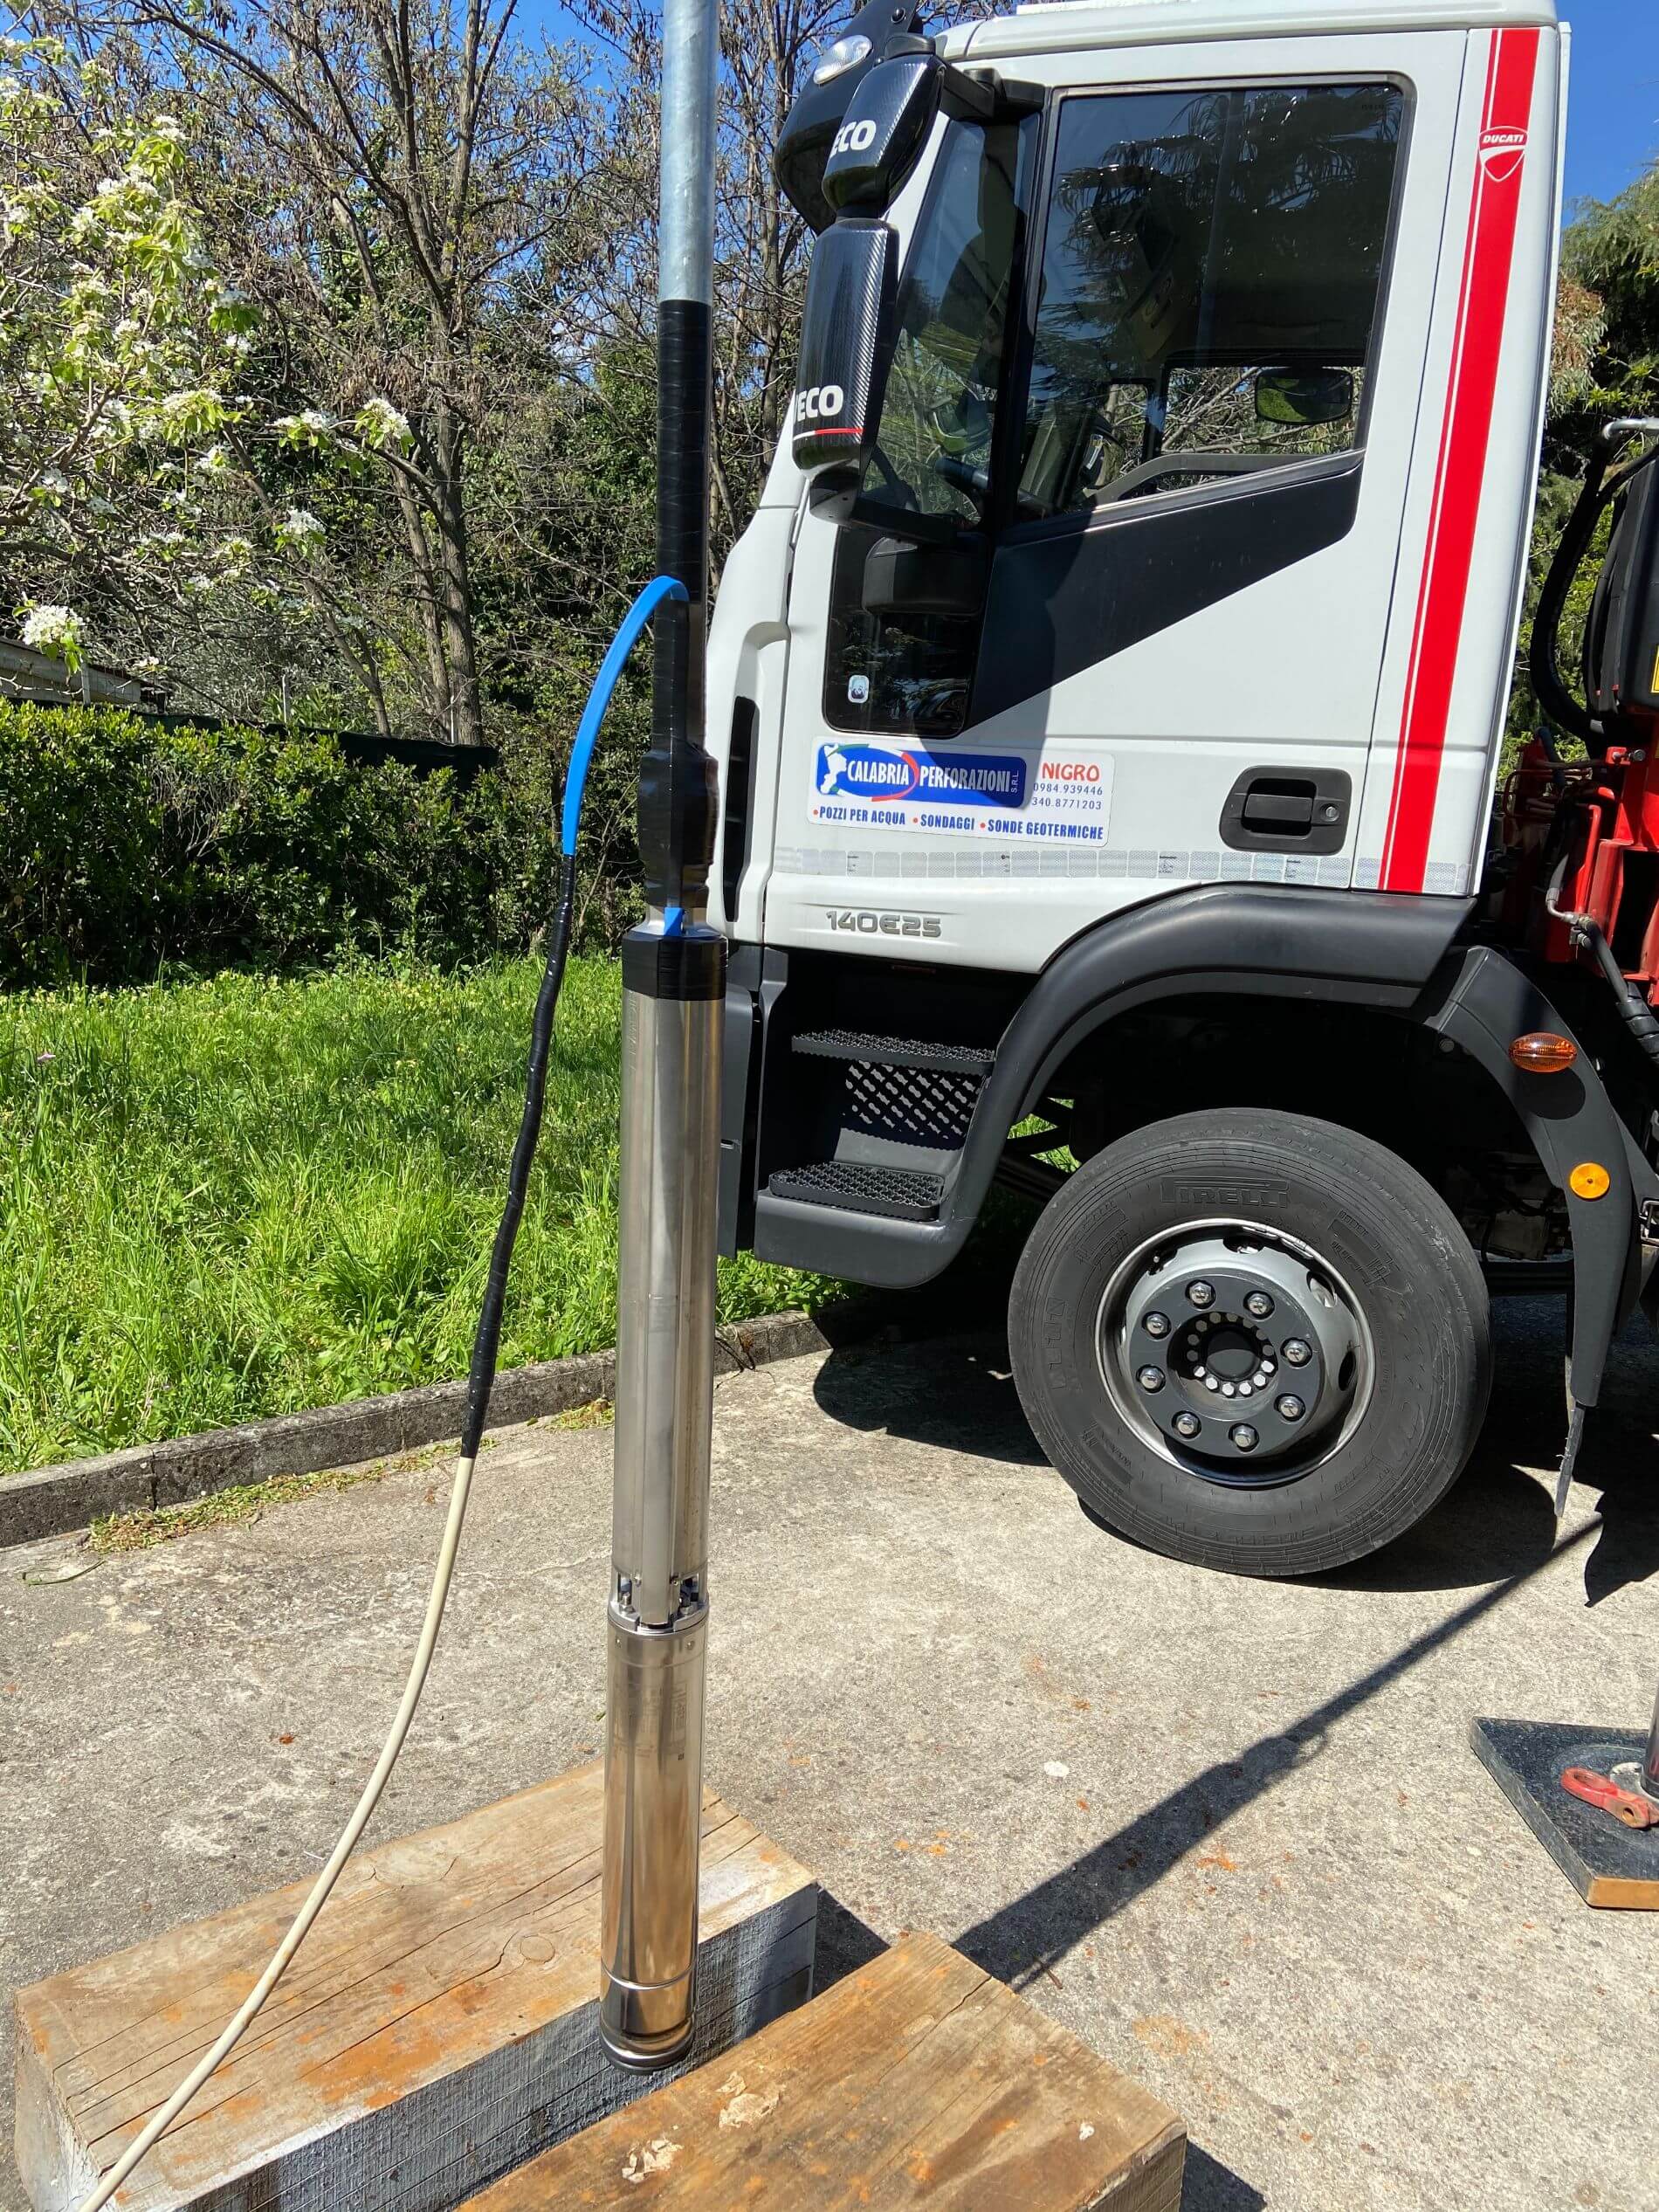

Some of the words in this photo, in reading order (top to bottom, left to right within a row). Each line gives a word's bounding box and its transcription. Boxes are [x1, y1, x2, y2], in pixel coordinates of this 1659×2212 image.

[1483, 134, 1525, 144] DUCATI
[795, 384, 844, 423] ECO
[847, 760, 909, 786] CALABRIA
[919, 765, 1011, 793] PERFORAZIONI
[1042, 762, 1100, 782] NIGRO
[1033, 782, 1104, 796] 0984.939446
[1032, 797, 1102, 810] 340.8771203
[819, 806, 847, 821] POZZI
[850, 809, 868, 823] PER
[871, 810, 905, 825] ACQUA
[920, 814, 974, 830] SONDAGGI
[988, 819, 1022, 834] SONDE
[1026, 822, 1104, 840] GEOTERMICHE
[826, 910, 942, 938] 140E25
[1160, 1175, 1290, 1209] PIRELLI
